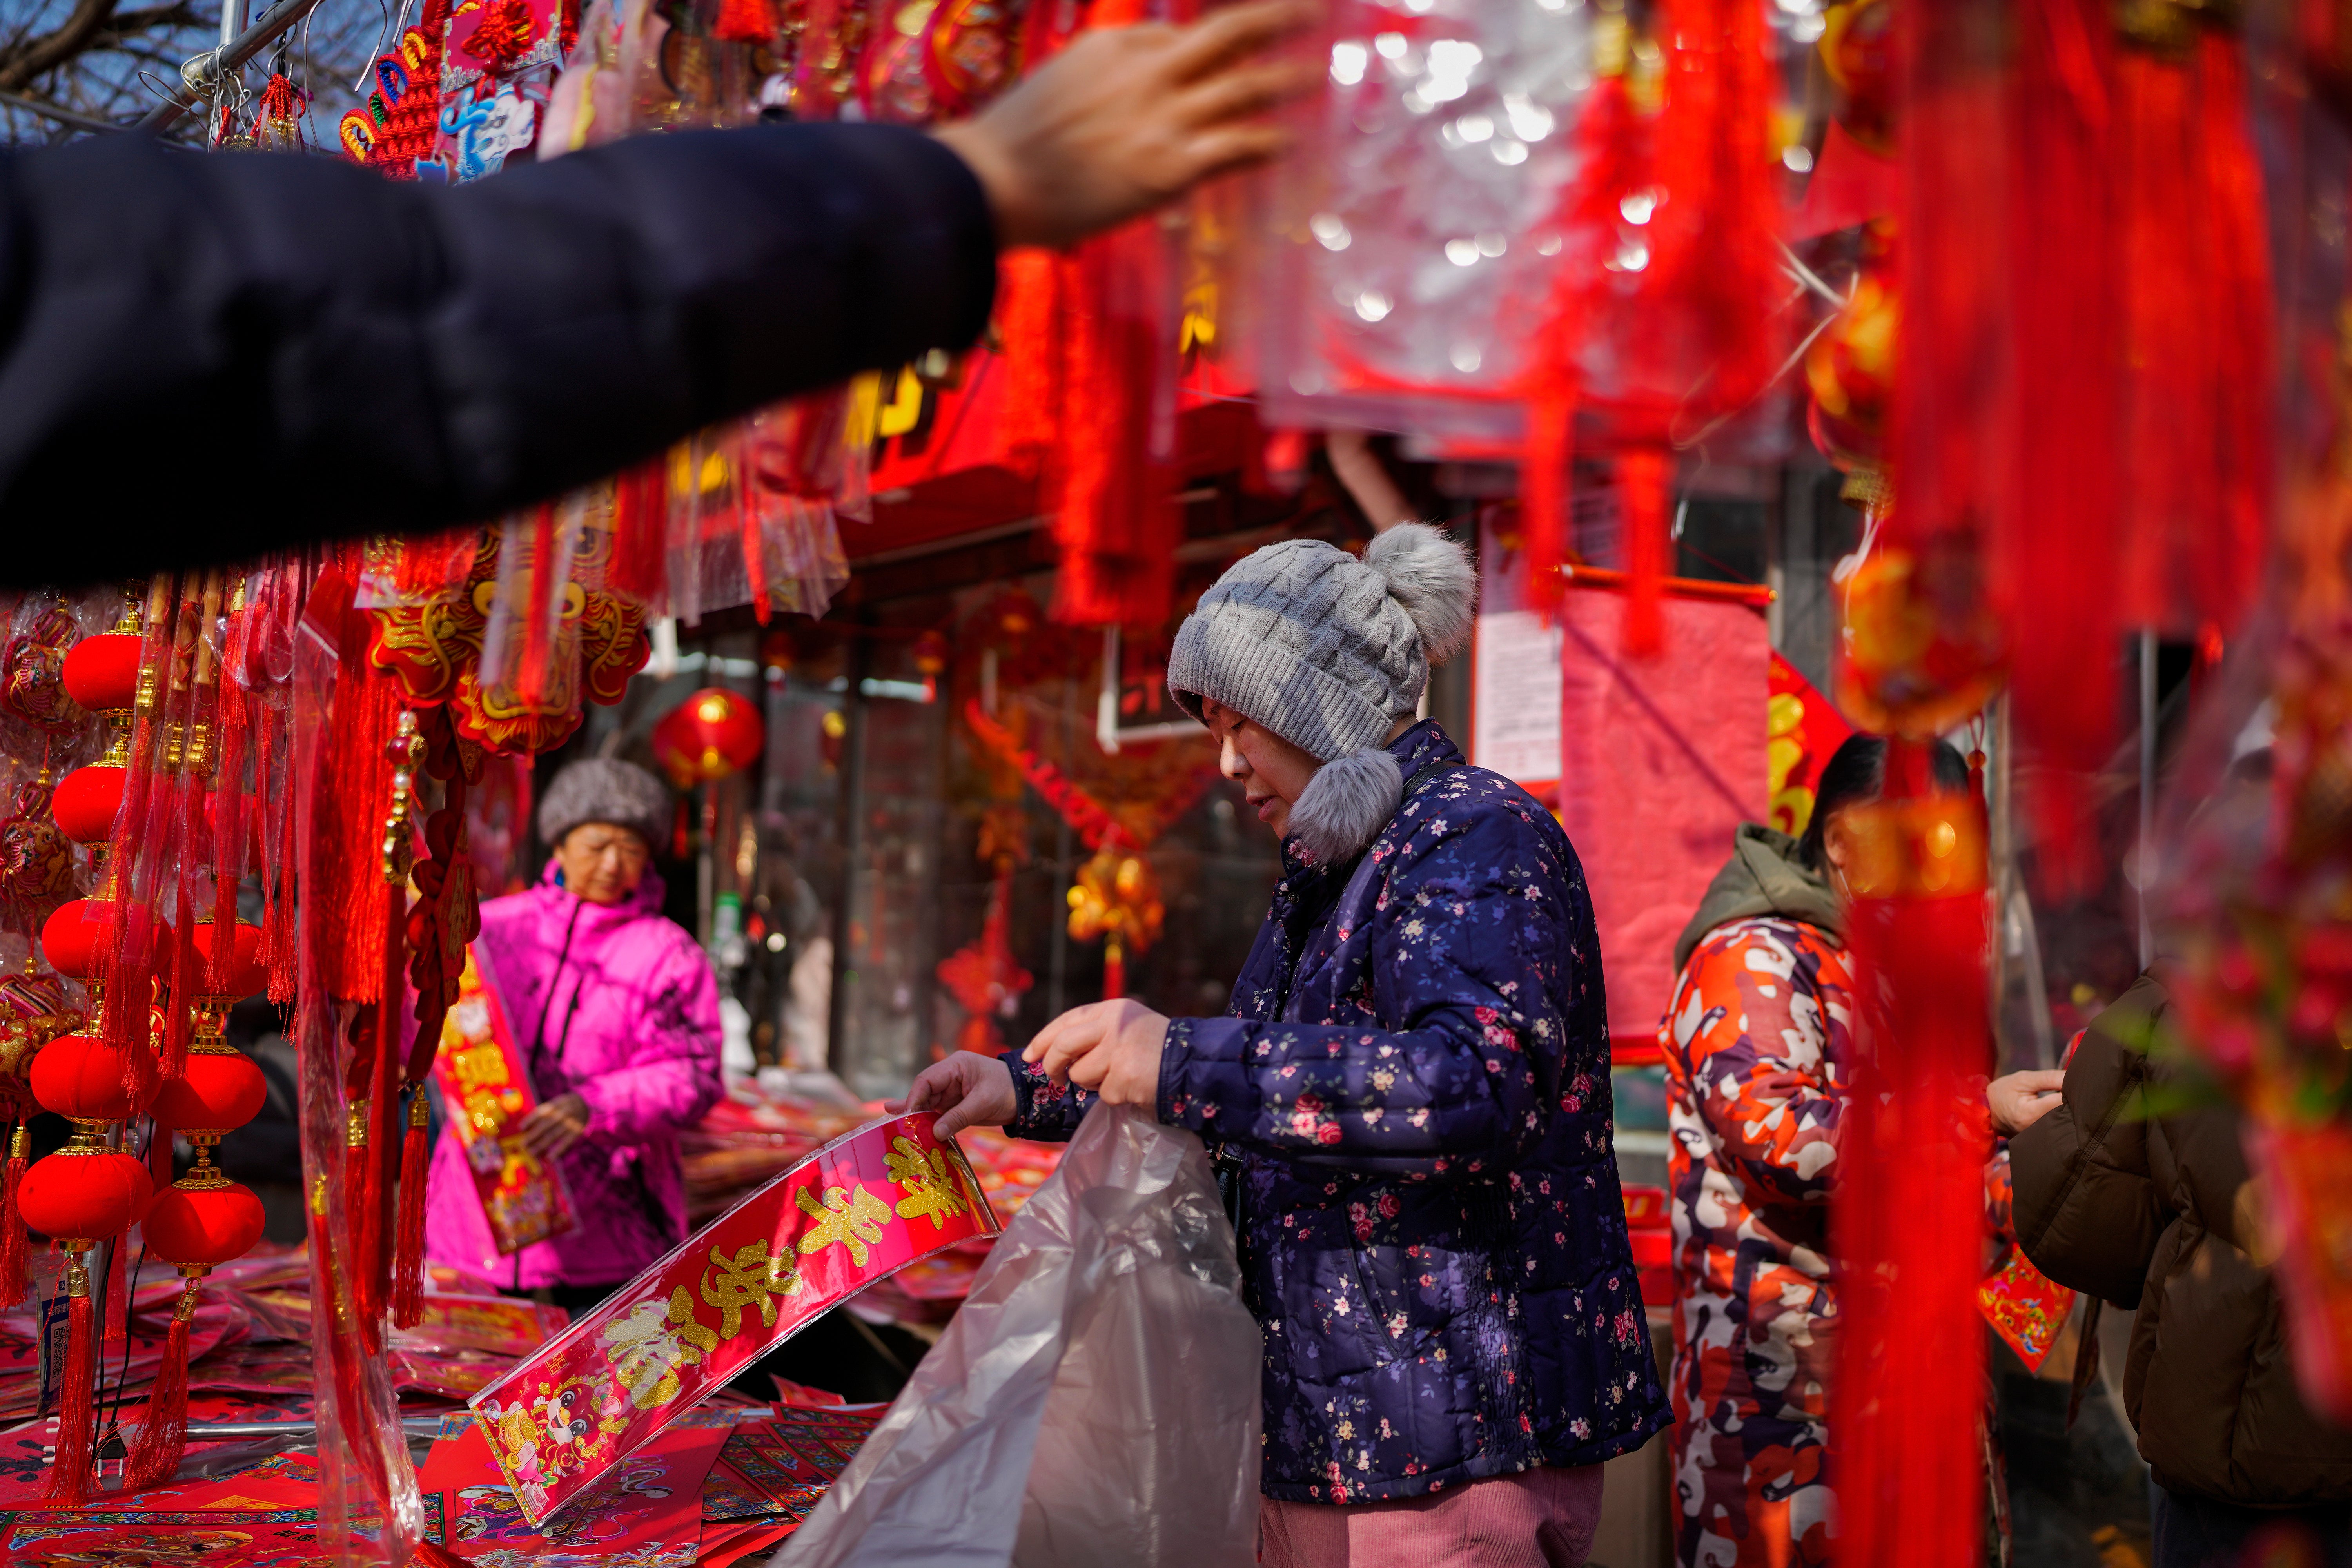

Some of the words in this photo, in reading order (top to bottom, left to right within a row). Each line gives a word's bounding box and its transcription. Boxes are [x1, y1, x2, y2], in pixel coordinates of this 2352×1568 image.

[604, 1135, 982, 1410] 祥平安福
[273, 1530, 317, 1543] 如意
